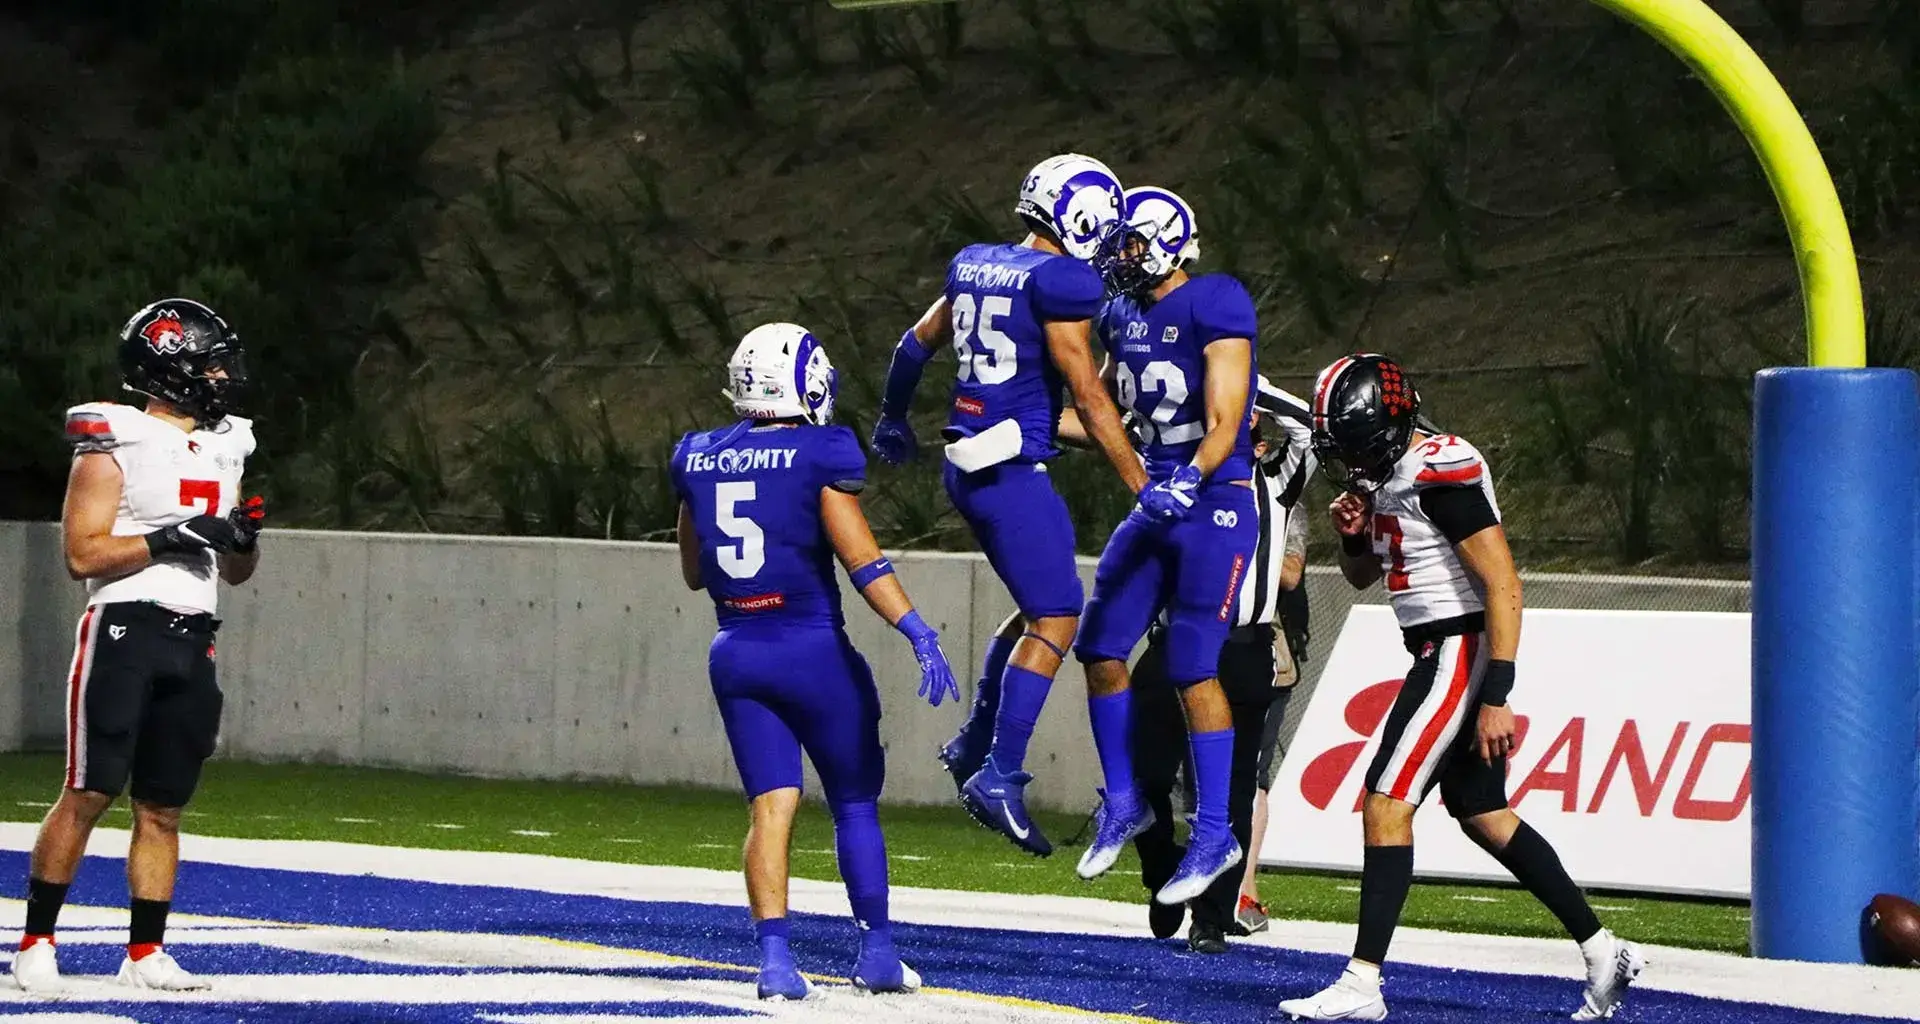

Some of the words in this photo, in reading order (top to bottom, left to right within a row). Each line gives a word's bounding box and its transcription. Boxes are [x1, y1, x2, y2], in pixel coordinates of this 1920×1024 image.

[956, 263, 979, 282] TEC
[997, 268, 1031, 290] MTY
[952, 293, 1017, 385] 85
[743, 367, 754, 386] 5
[685, 451, 717, 473] TEC
[752, 448, 798, 469] MTY
[179, 478, 220, 518] 7
[715, 481, 765, 579] 5
[1368, 512, 1412, 592] 7
